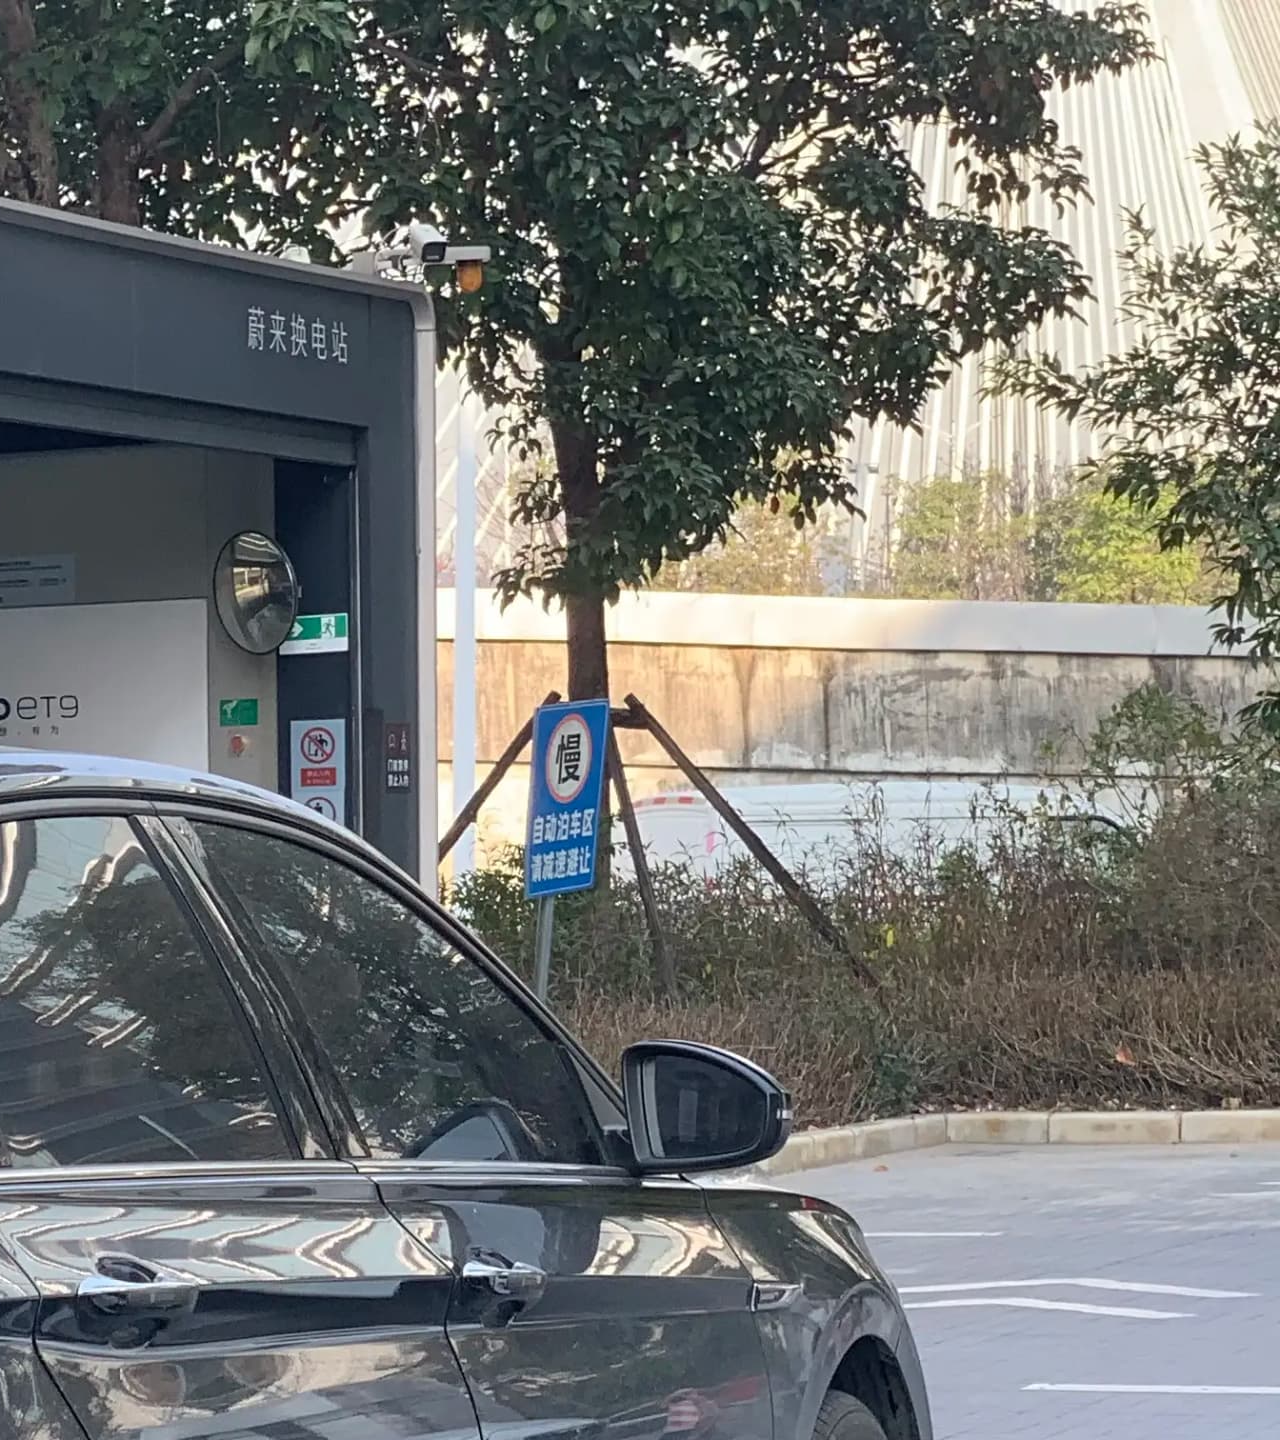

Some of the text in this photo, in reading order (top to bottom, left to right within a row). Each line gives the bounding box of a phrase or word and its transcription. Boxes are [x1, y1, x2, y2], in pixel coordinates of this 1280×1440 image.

[247, 305, 348, 364] 蔚来换电站
[555, 733, 582, 785] 慢
[533, 808, 595, 845] 自动泊车区
[531, 845, 591, 882] 请减速避让
